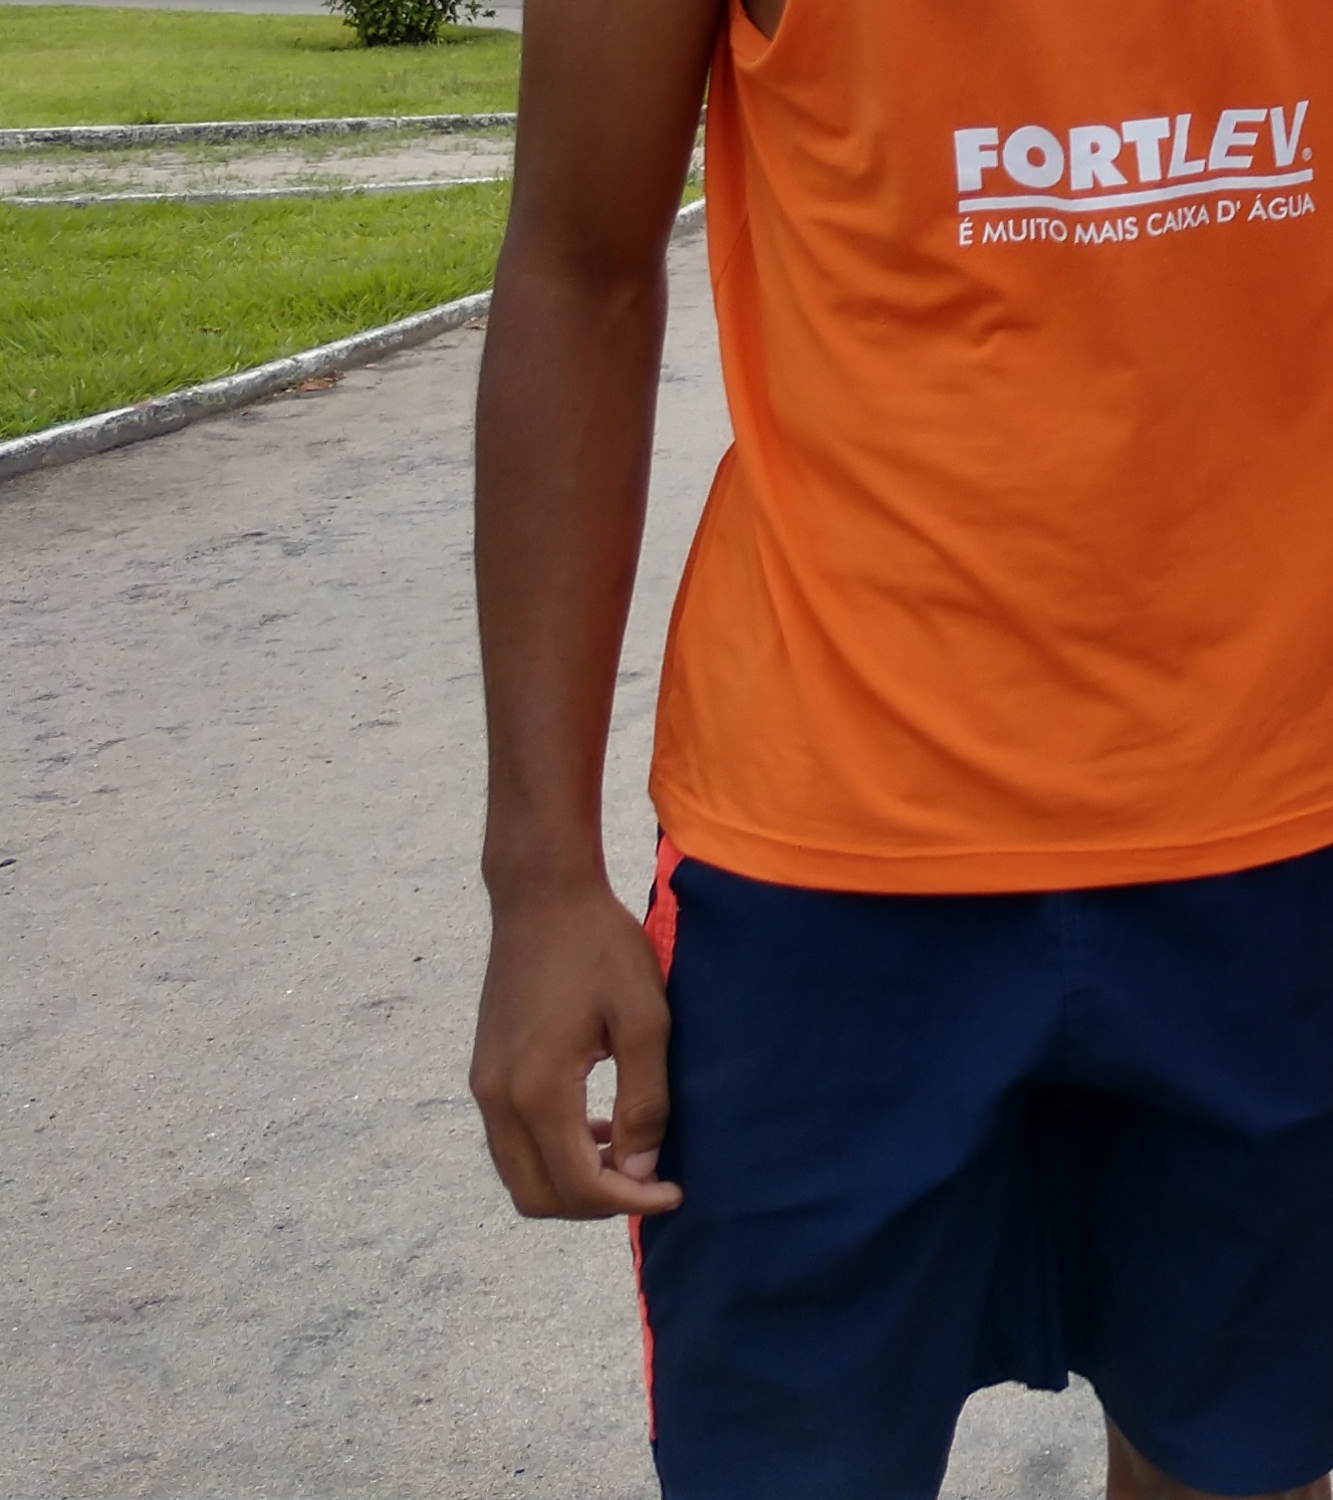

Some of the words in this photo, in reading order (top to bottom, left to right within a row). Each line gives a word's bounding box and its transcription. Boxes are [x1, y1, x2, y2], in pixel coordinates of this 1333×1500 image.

[957, 216, 974, 247] É
[981, 217, 1068, 245] MUITO
[1074, 215, 1139, 245] MAIS
[1146, 204, 1210, 236] CAIXA
[1247, 193, 1315, 221] ÁGUA
